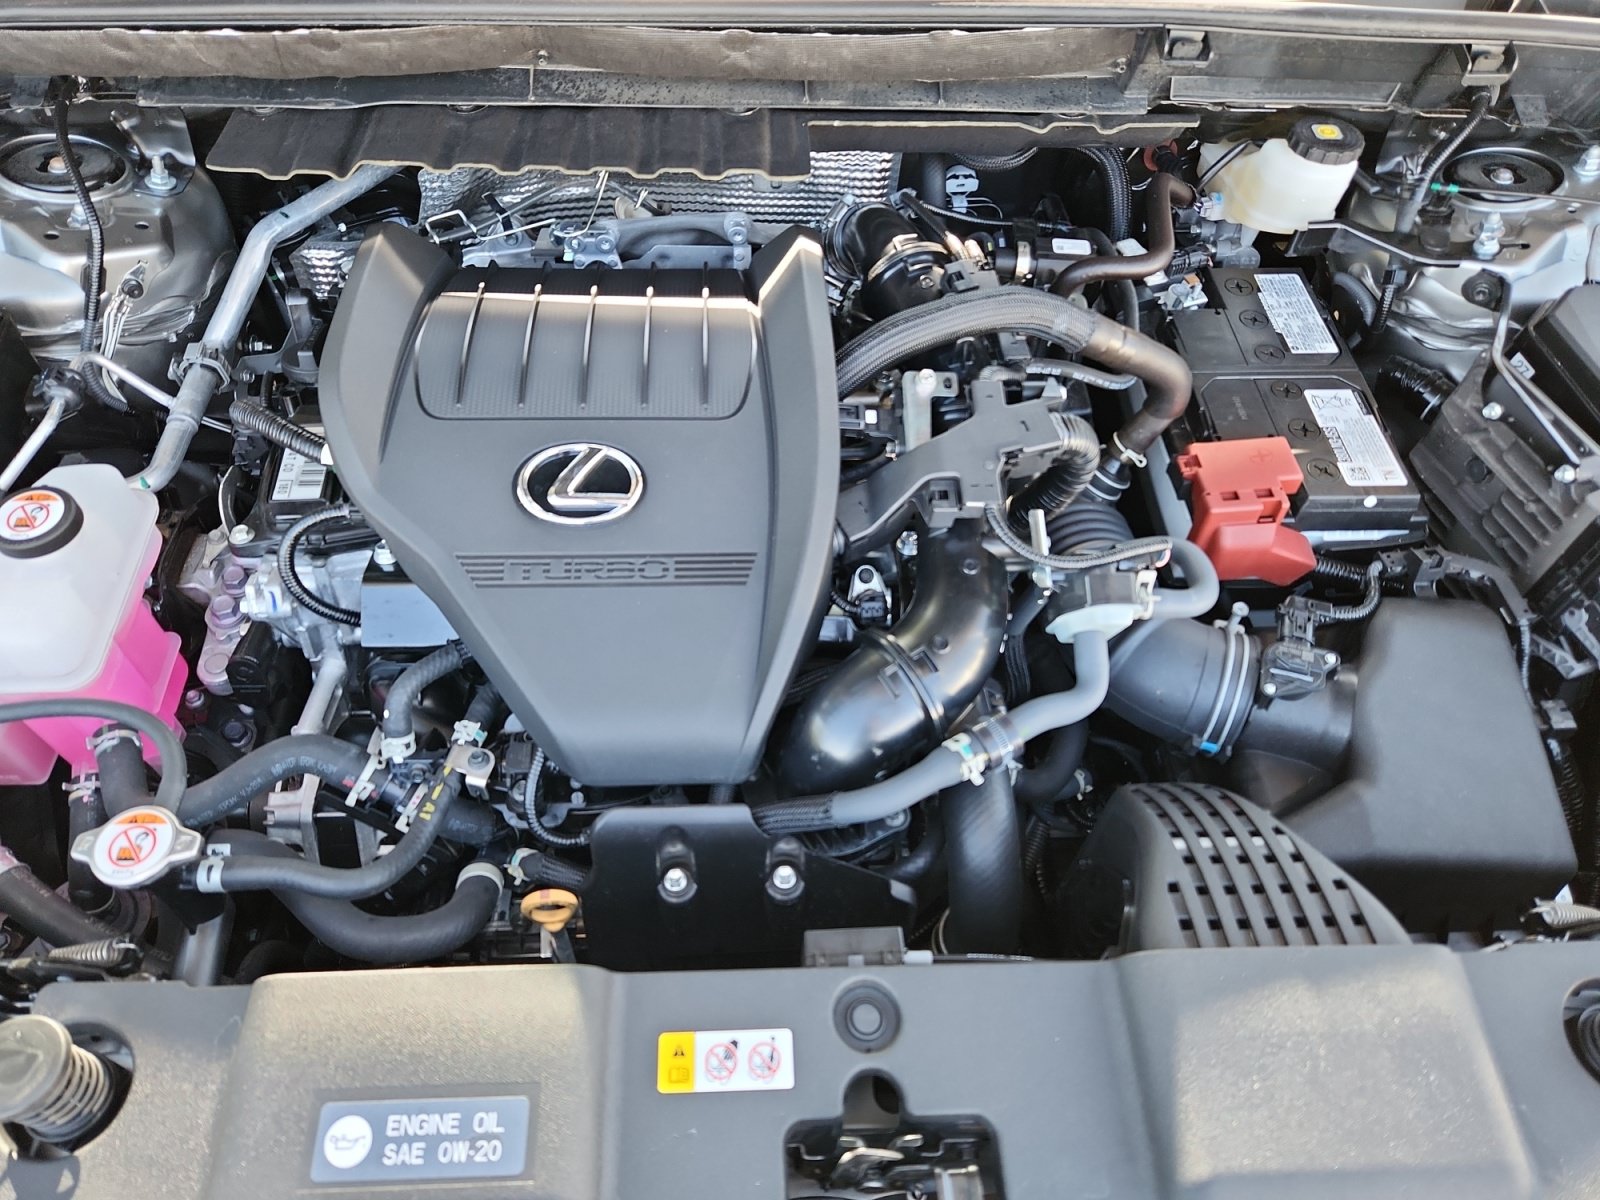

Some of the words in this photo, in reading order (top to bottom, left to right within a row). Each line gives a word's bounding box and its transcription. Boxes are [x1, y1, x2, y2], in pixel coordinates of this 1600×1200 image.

[507, 559, 670, 581] TURBO
[386, 1112, 462, 1137] ENGINE
[472, 1111, 505, 1134] OIL
[382, 1141, 426, 1166] SAE
[437, 1140, 503, 1163] 0W-20
